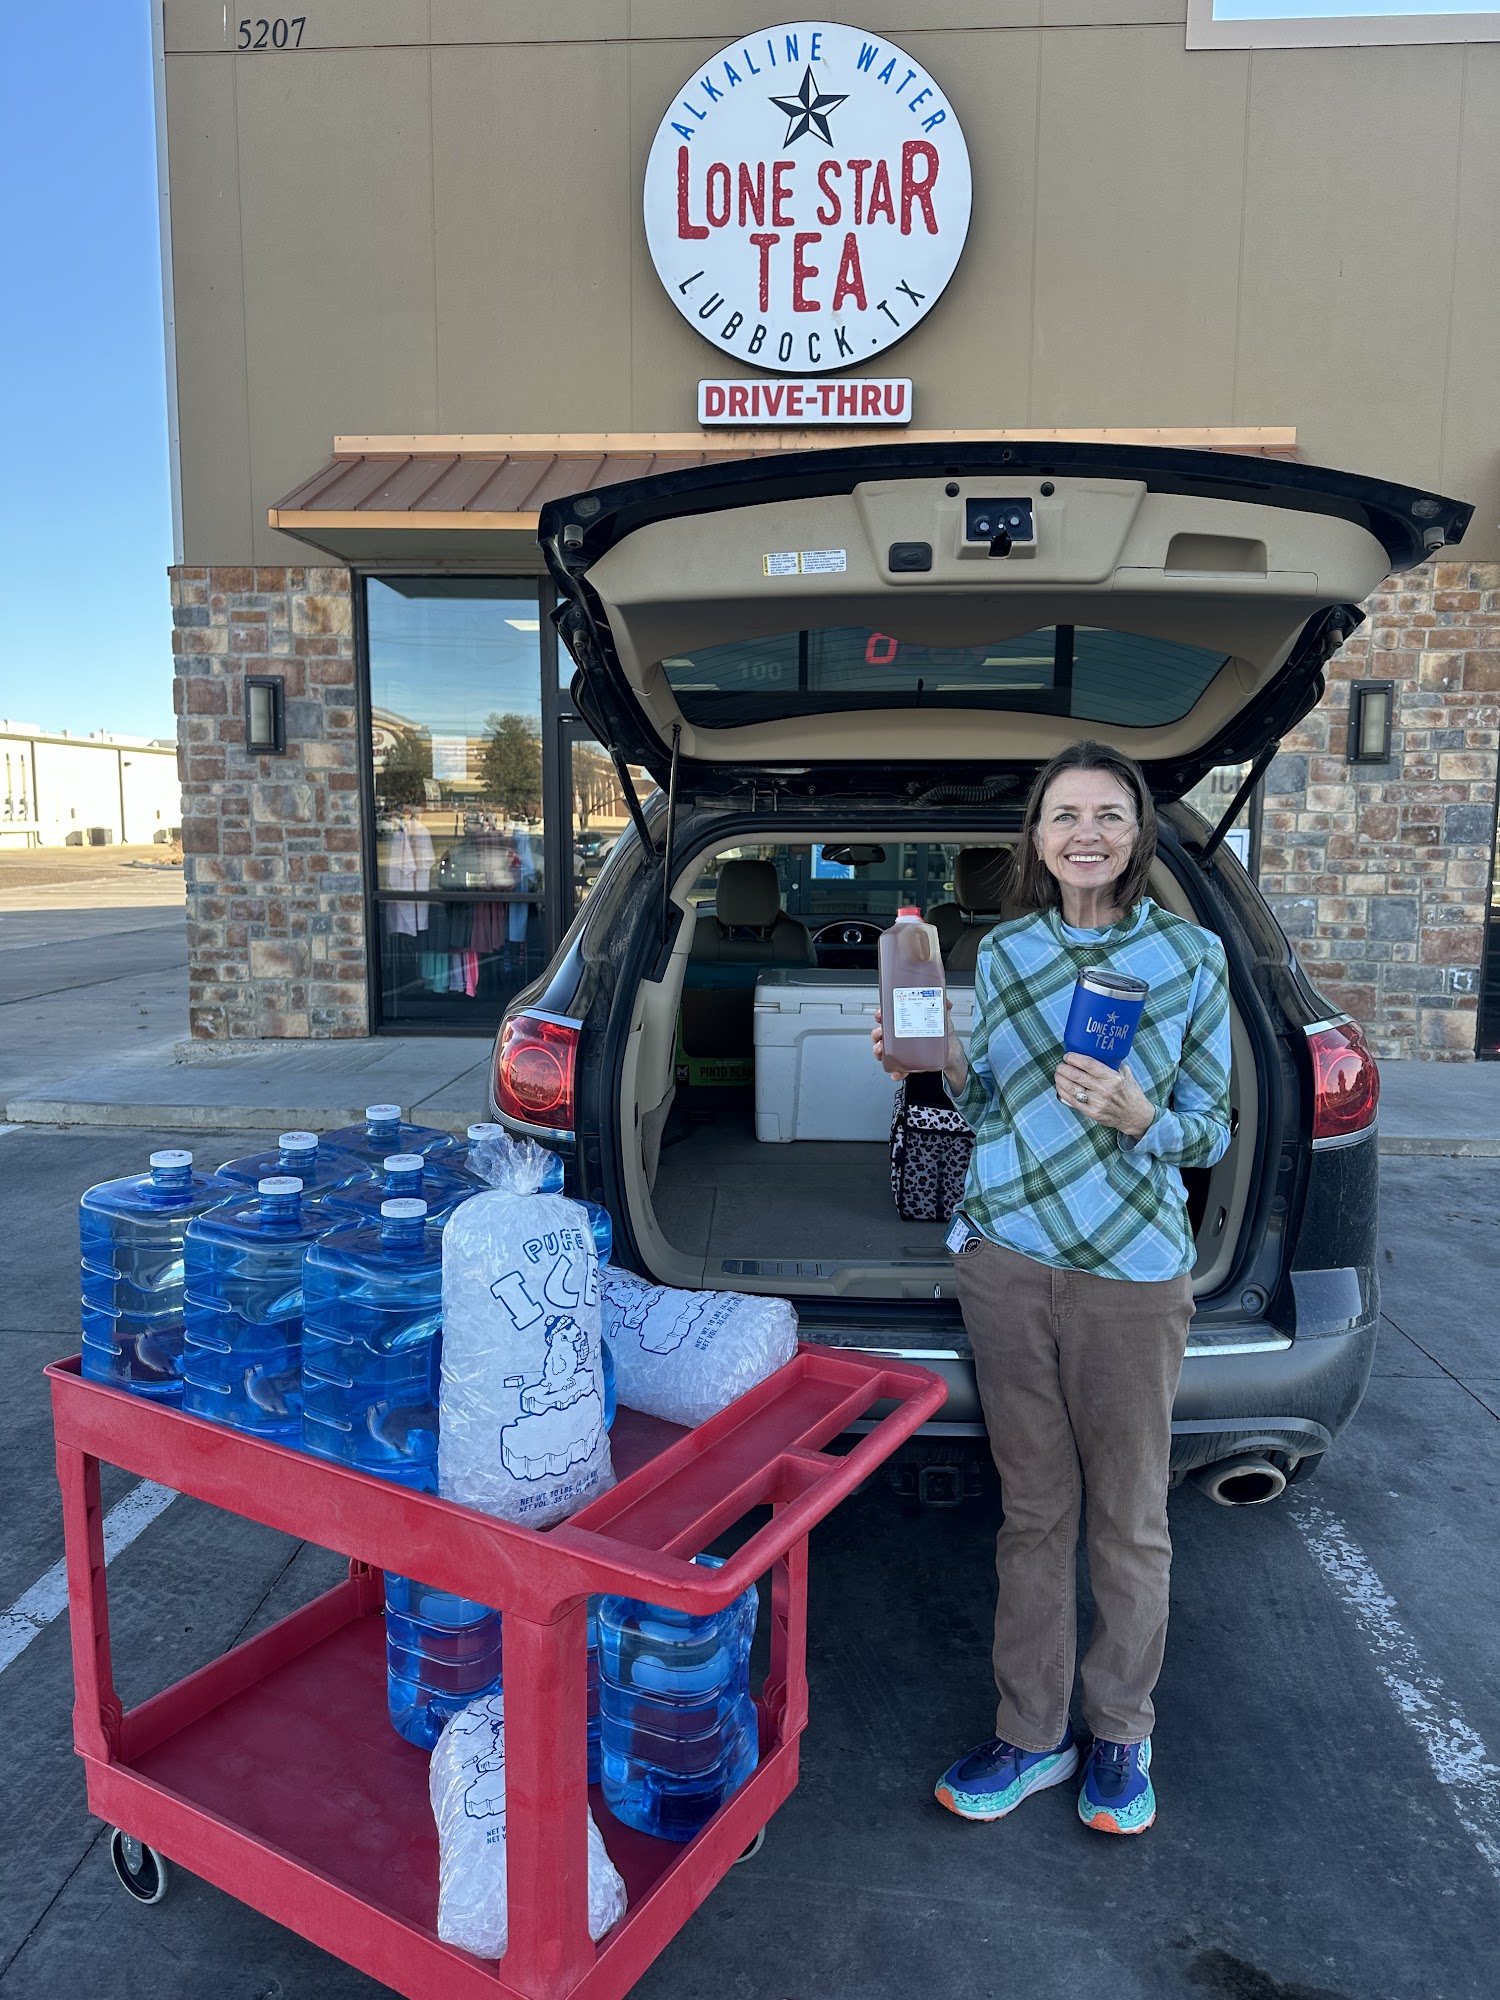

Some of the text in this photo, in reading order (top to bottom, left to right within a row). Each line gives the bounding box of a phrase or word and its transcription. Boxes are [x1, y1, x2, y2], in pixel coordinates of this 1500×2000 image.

[238, 16, 306, 49] 5207
[671, 33, 946, 141] ALKALINE WATER
[677, 140, 939, 240] LONE STAR
[749, 231, 868, 313] TEA
[704, 384, 906, 418] DRIVE-THRU
[1086, 1016, 1129, 1040] LONE STAR
[1095, 1033, 1115, 1050] TEA
[518, 1505, 532, 1514] NET
[520, 1496, 533, 1505] NET
[486, 1827, 499, 1837] NET
[486, 1835, 500, 1844] NET
